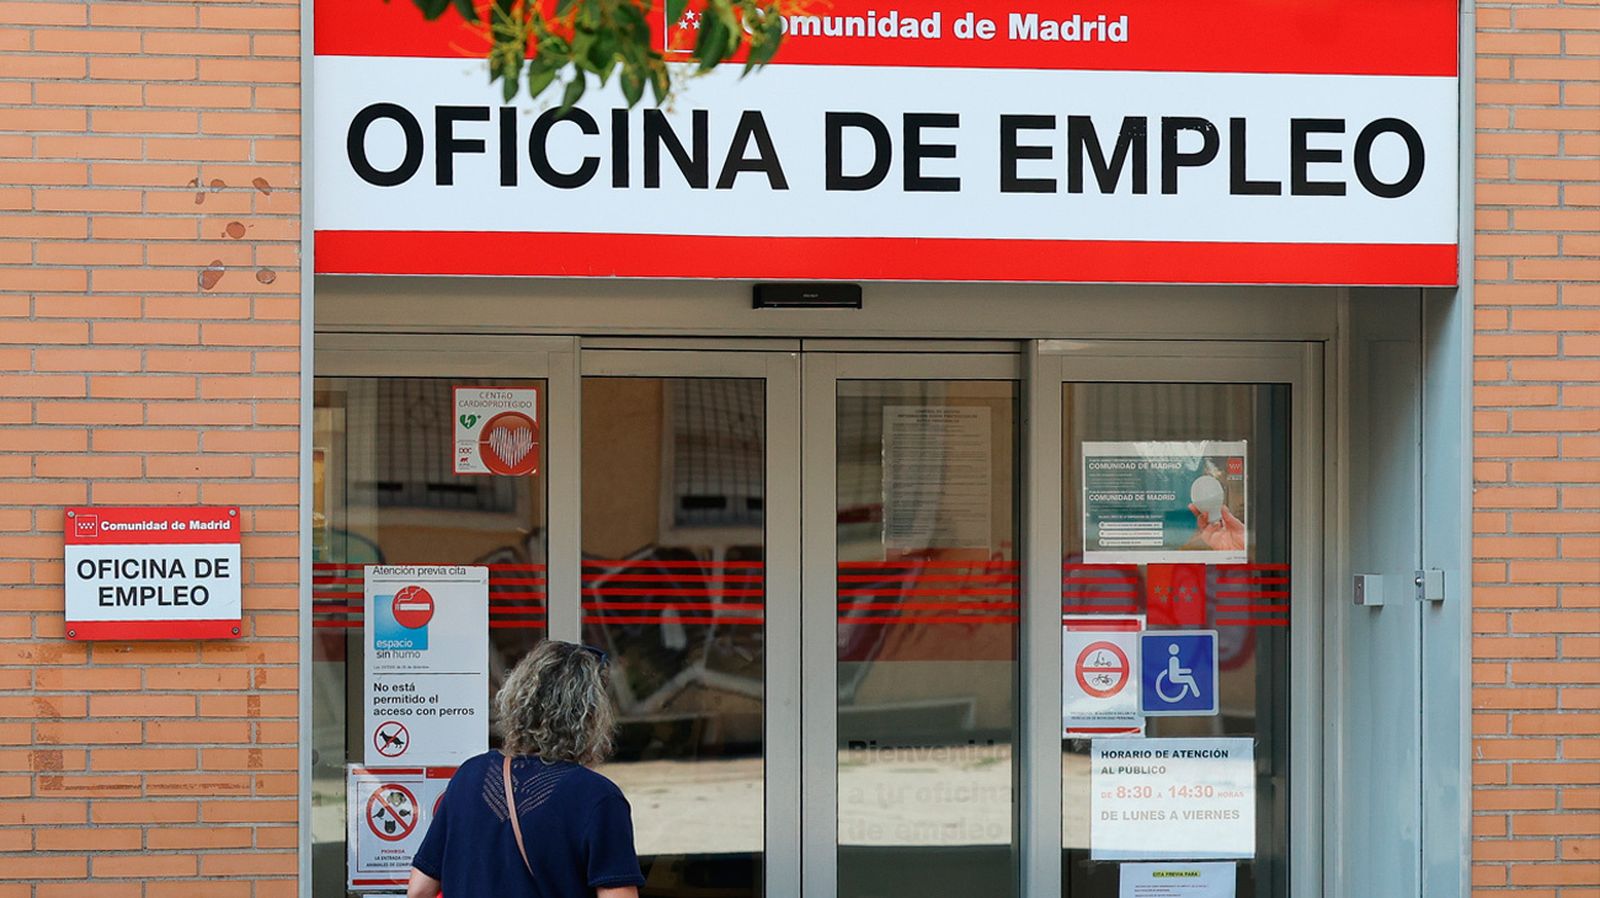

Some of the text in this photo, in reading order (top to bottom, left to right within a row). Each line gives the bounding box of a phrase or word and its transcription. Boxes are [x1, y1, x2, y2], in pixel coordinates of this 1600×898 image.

[953, 13, 996, 40] de
[1008, 13, 1129, 43] Madrid
[346, 101, 1426, 199] OFICINA DE EMPLEO
[479, 392, 513, 400] CENTRO
[101, 520, 231, 531] Comunidad de Madrid
[77, 558, 230, 580] OFICINA DE
[373, 565, 466, 577] Atención previa cita
[98, 585, 210, 607] EMPLEO
[376, 638, 413, 649] espacio
[376, 650, 421, 659] sin humo
[373, 682, 416, 692] No está
[373, 694, 439, 705] permitido el
[373, 708, 475, 718] acceso con perros
[1101, 748, 1229, 759] HORARIO DE ATENCIÓN
[1101, 764, 1167, 775] AL PÚBLICO
[1101, 791, 1112, 799] DE
[1116, 786, 1153, 799] 8:30
[1157, 791, 1163, 799] A
[1168, 785, 1214, 799] 14:30
[1101, 809, 1240, 821] DE LUNES A VIERNES
